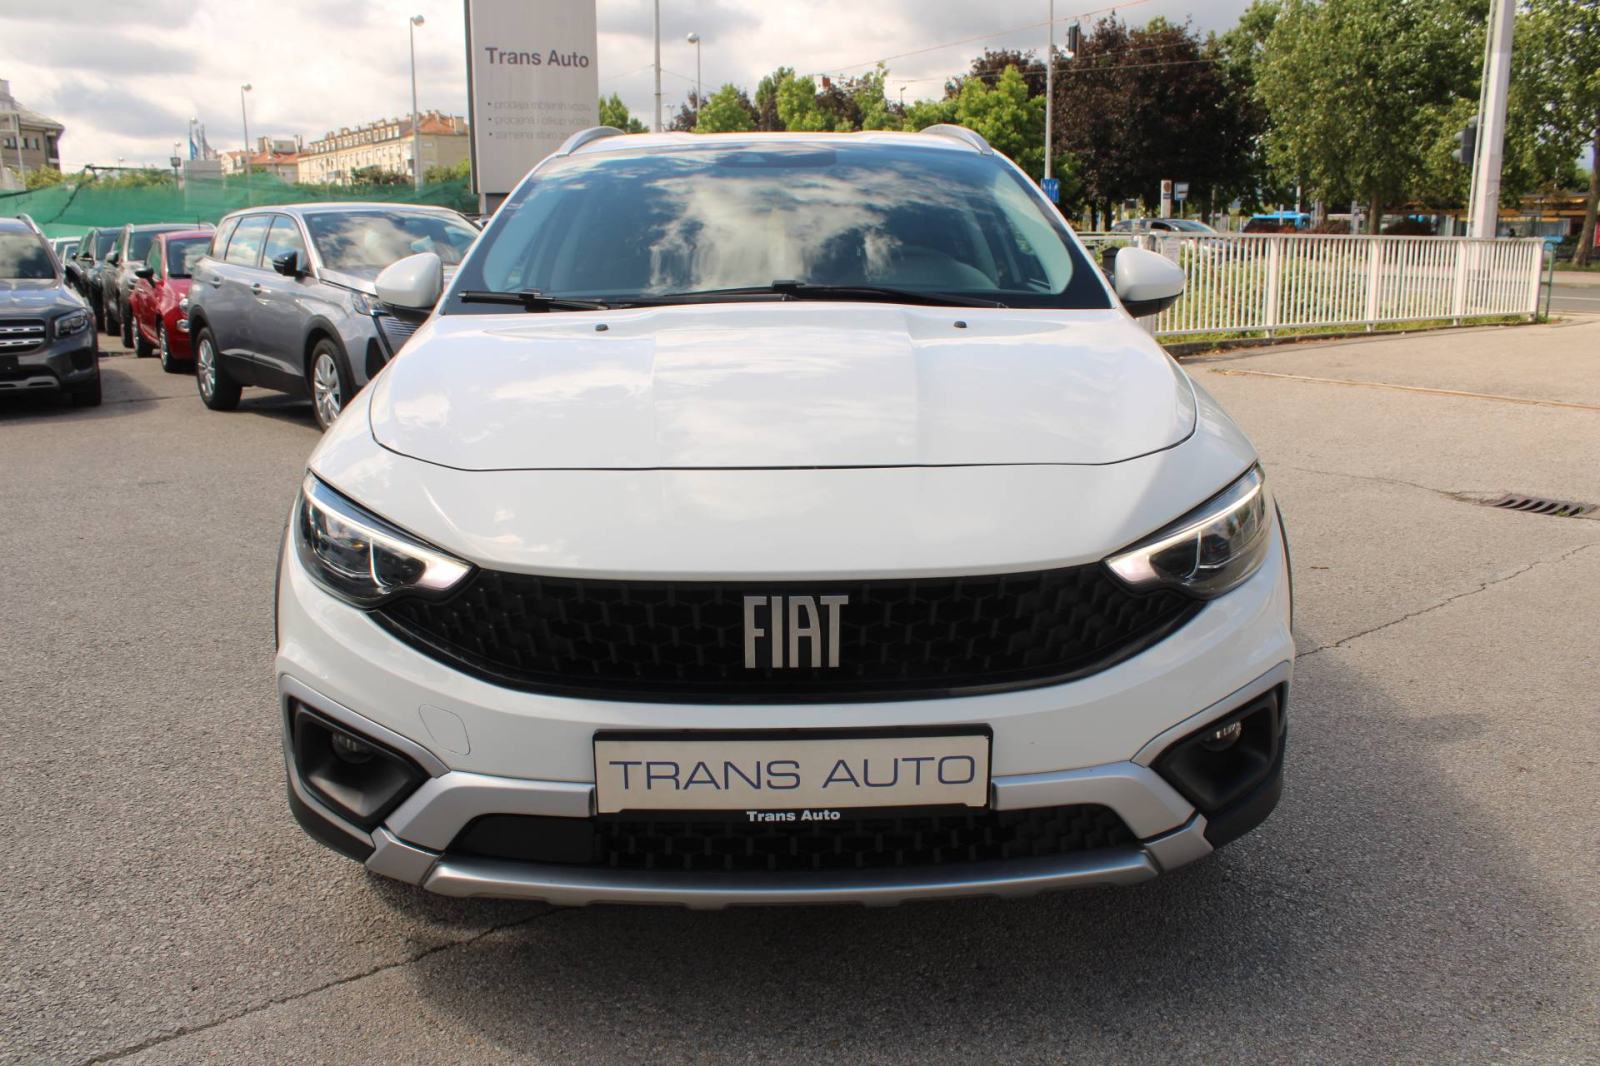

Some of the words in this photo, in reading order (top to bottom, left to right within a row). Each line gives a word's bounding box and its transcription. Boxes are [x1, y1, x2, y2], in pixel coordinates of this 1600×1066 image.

[485, 47, 542, 65] Trans
[547, 49, 589, 68] Auto
[743, 595, 849, 669] FIAT
[609, 760, 800, 790] TRANS
[822, 755, 975, 788] AUTO
[746, 811, 796, 822] Trans
[800, 809, 841, 821] Auto
